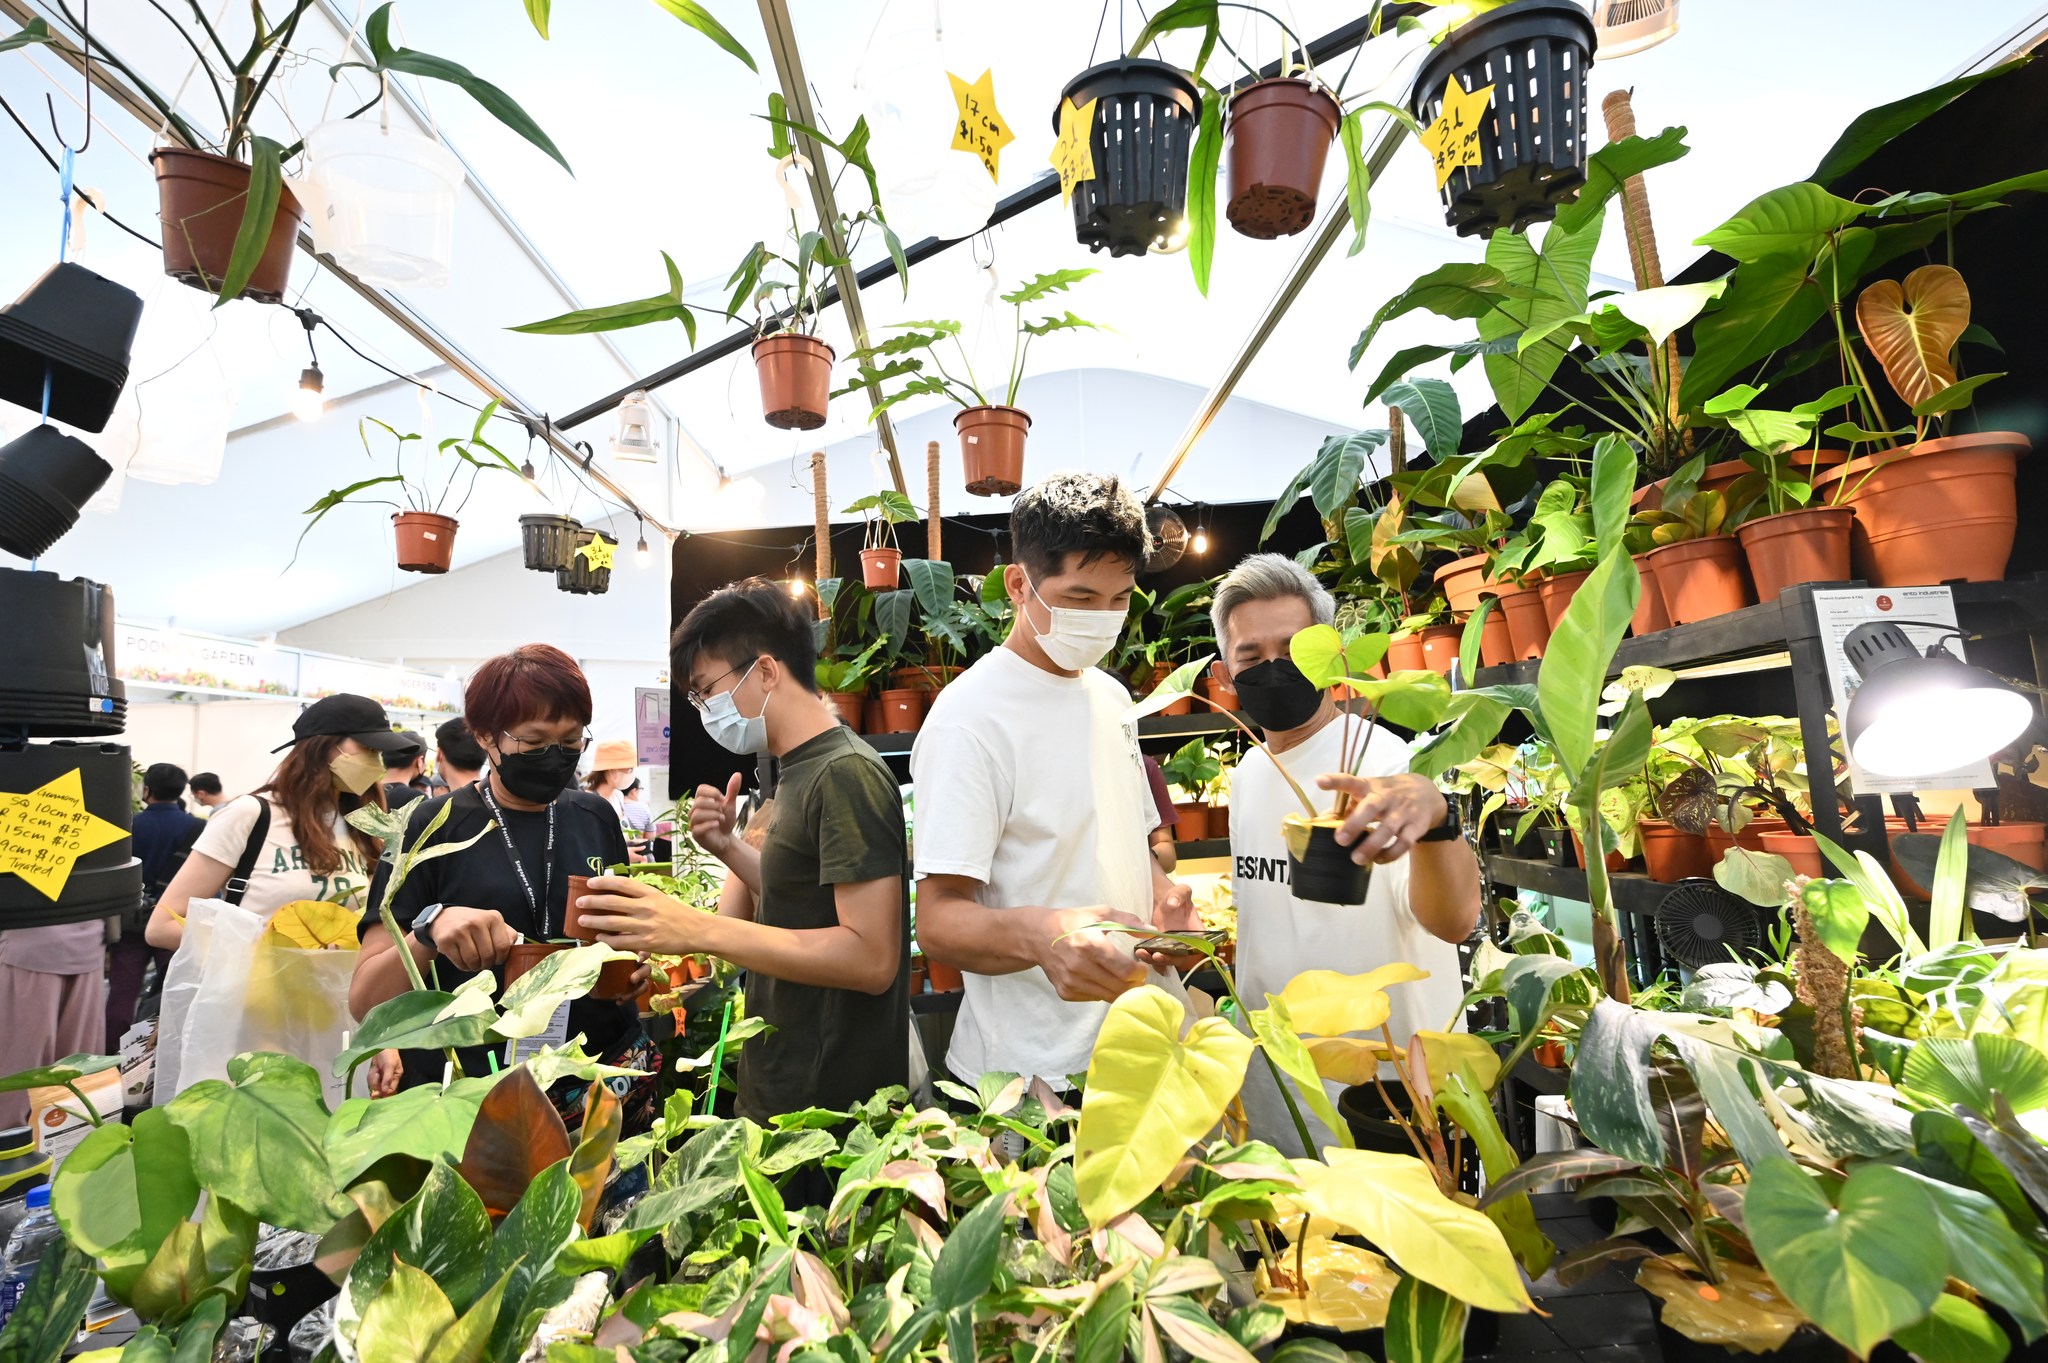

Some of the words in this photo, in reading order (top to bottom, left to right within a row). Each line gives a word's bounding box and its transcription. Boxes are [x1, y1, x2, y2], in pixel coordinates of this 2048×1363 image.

[965, 93, 980, 117] 17
[982, 115, 1000, 137] cm
[959, 119, 993, 156] $1.50
[1436, 130, 1478, 170] $5.00
[200, 647, 256, 667] GARDEN
[35, 803, 68, 819] 10cm
[71, 812, 90, 826] $9
[5, 824, 46, 841] 15cm
[51, 835, 80, 850] $10
[58, 823, 82, 838] $5
[494, 808, 505, 827] Garden
[501, 827, 514, 849] Festival
[547, 824, 555, 850] Singapore
[9, 857, 54, 878] Treated
[34, 848, 66, 865] $10
[514, 860, 530, 887] Singapore
